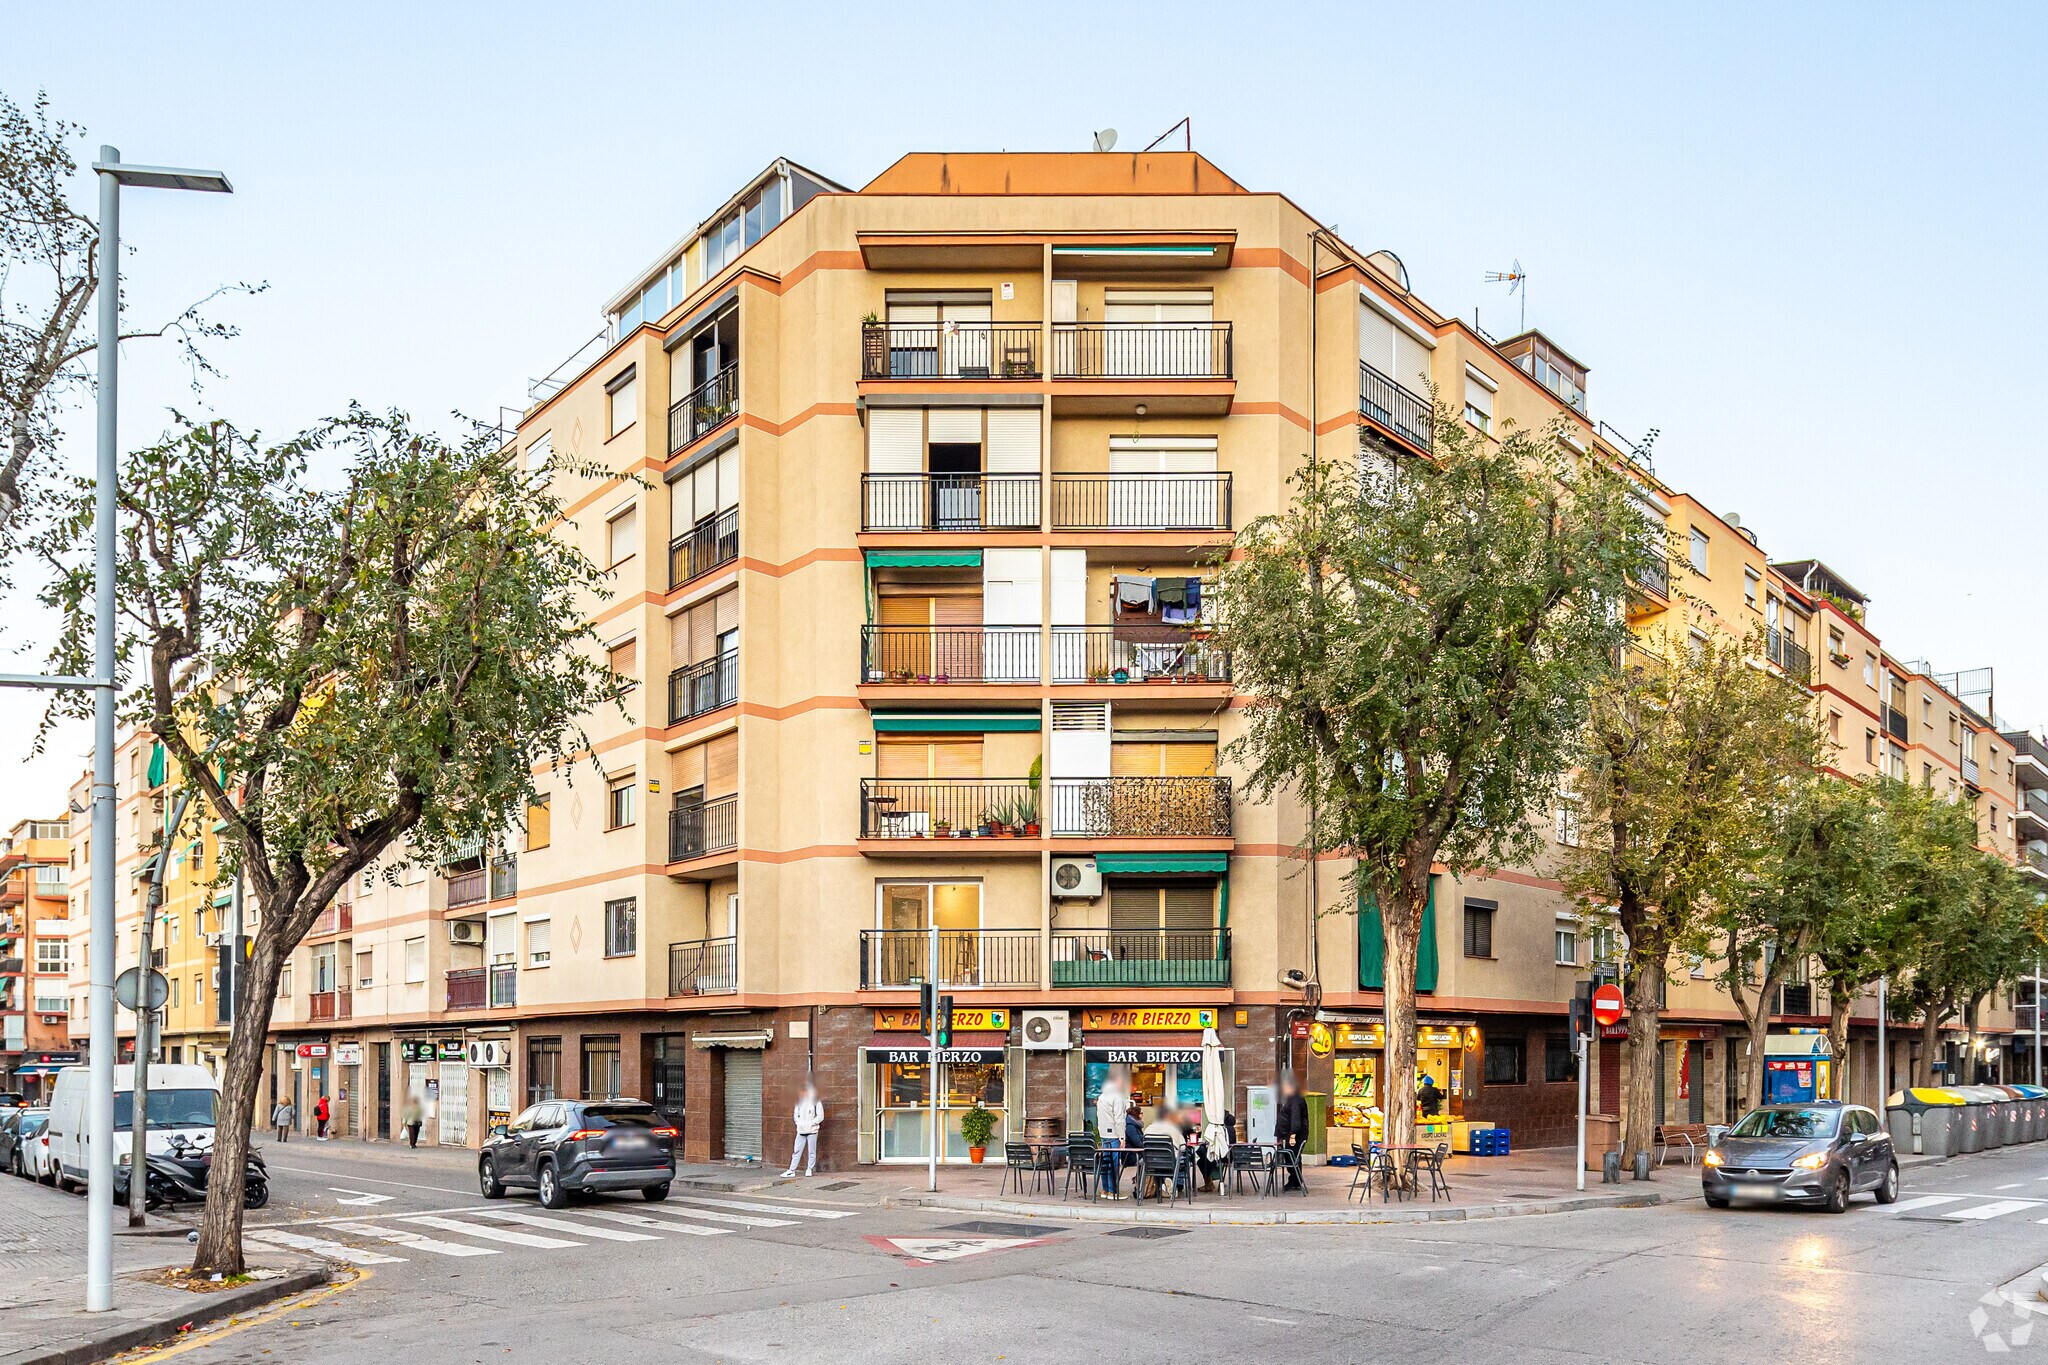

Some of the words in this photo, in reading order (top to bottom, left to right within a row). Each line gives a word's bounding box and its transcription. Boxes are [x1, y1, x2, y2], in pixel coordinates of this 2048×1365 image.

[1110, 1012, 1138, 1026] BAR
[1142, 1012, 1191, 1026] BIERZO
[889, 1051, 919, 1063] BAR
[1107, 1051, 1138, 1063] BAR
[1146, 1051, 1201, 1063] BIERZO
